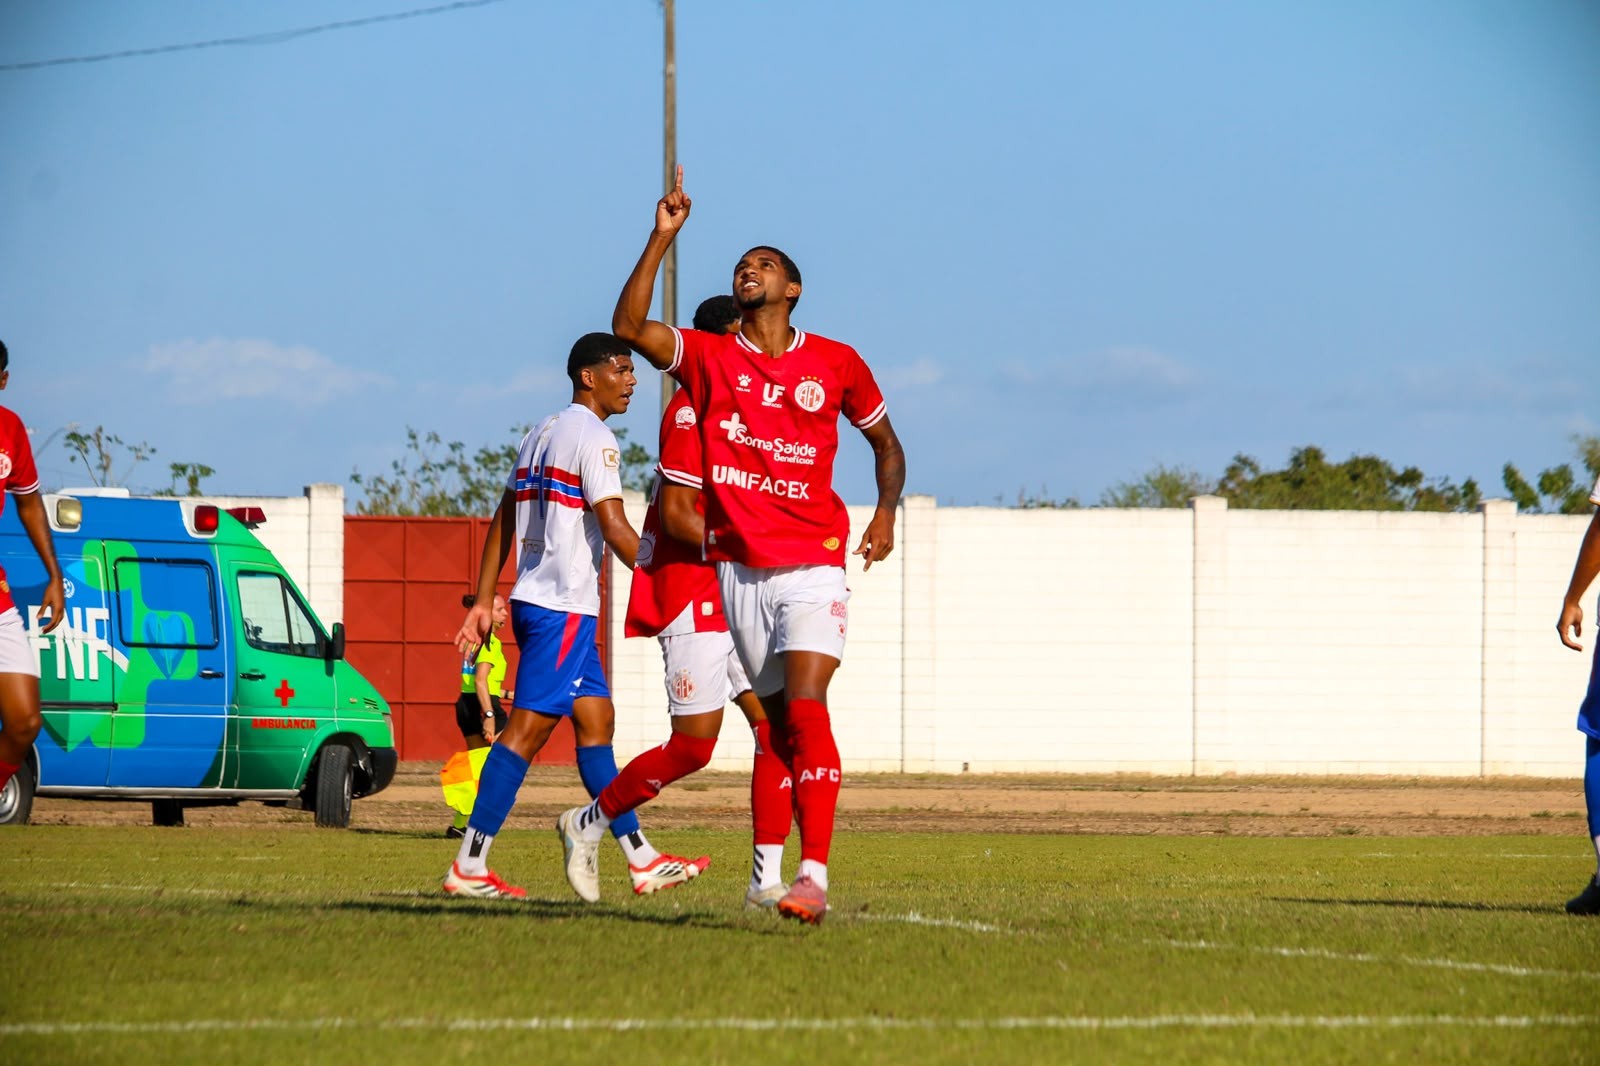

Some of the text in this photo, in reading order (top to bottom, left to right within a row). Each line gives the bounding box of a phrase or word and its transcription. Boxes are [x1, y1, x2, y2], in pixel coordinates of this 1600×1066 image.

[763, 382, 786, 403] UF
[773, 452, 814, 465] Benefícios
[712, 465, 810, 499] UNIFACEX
[27, 605, 110, 681] FNF
[799, 766, 840, 783] AFC
